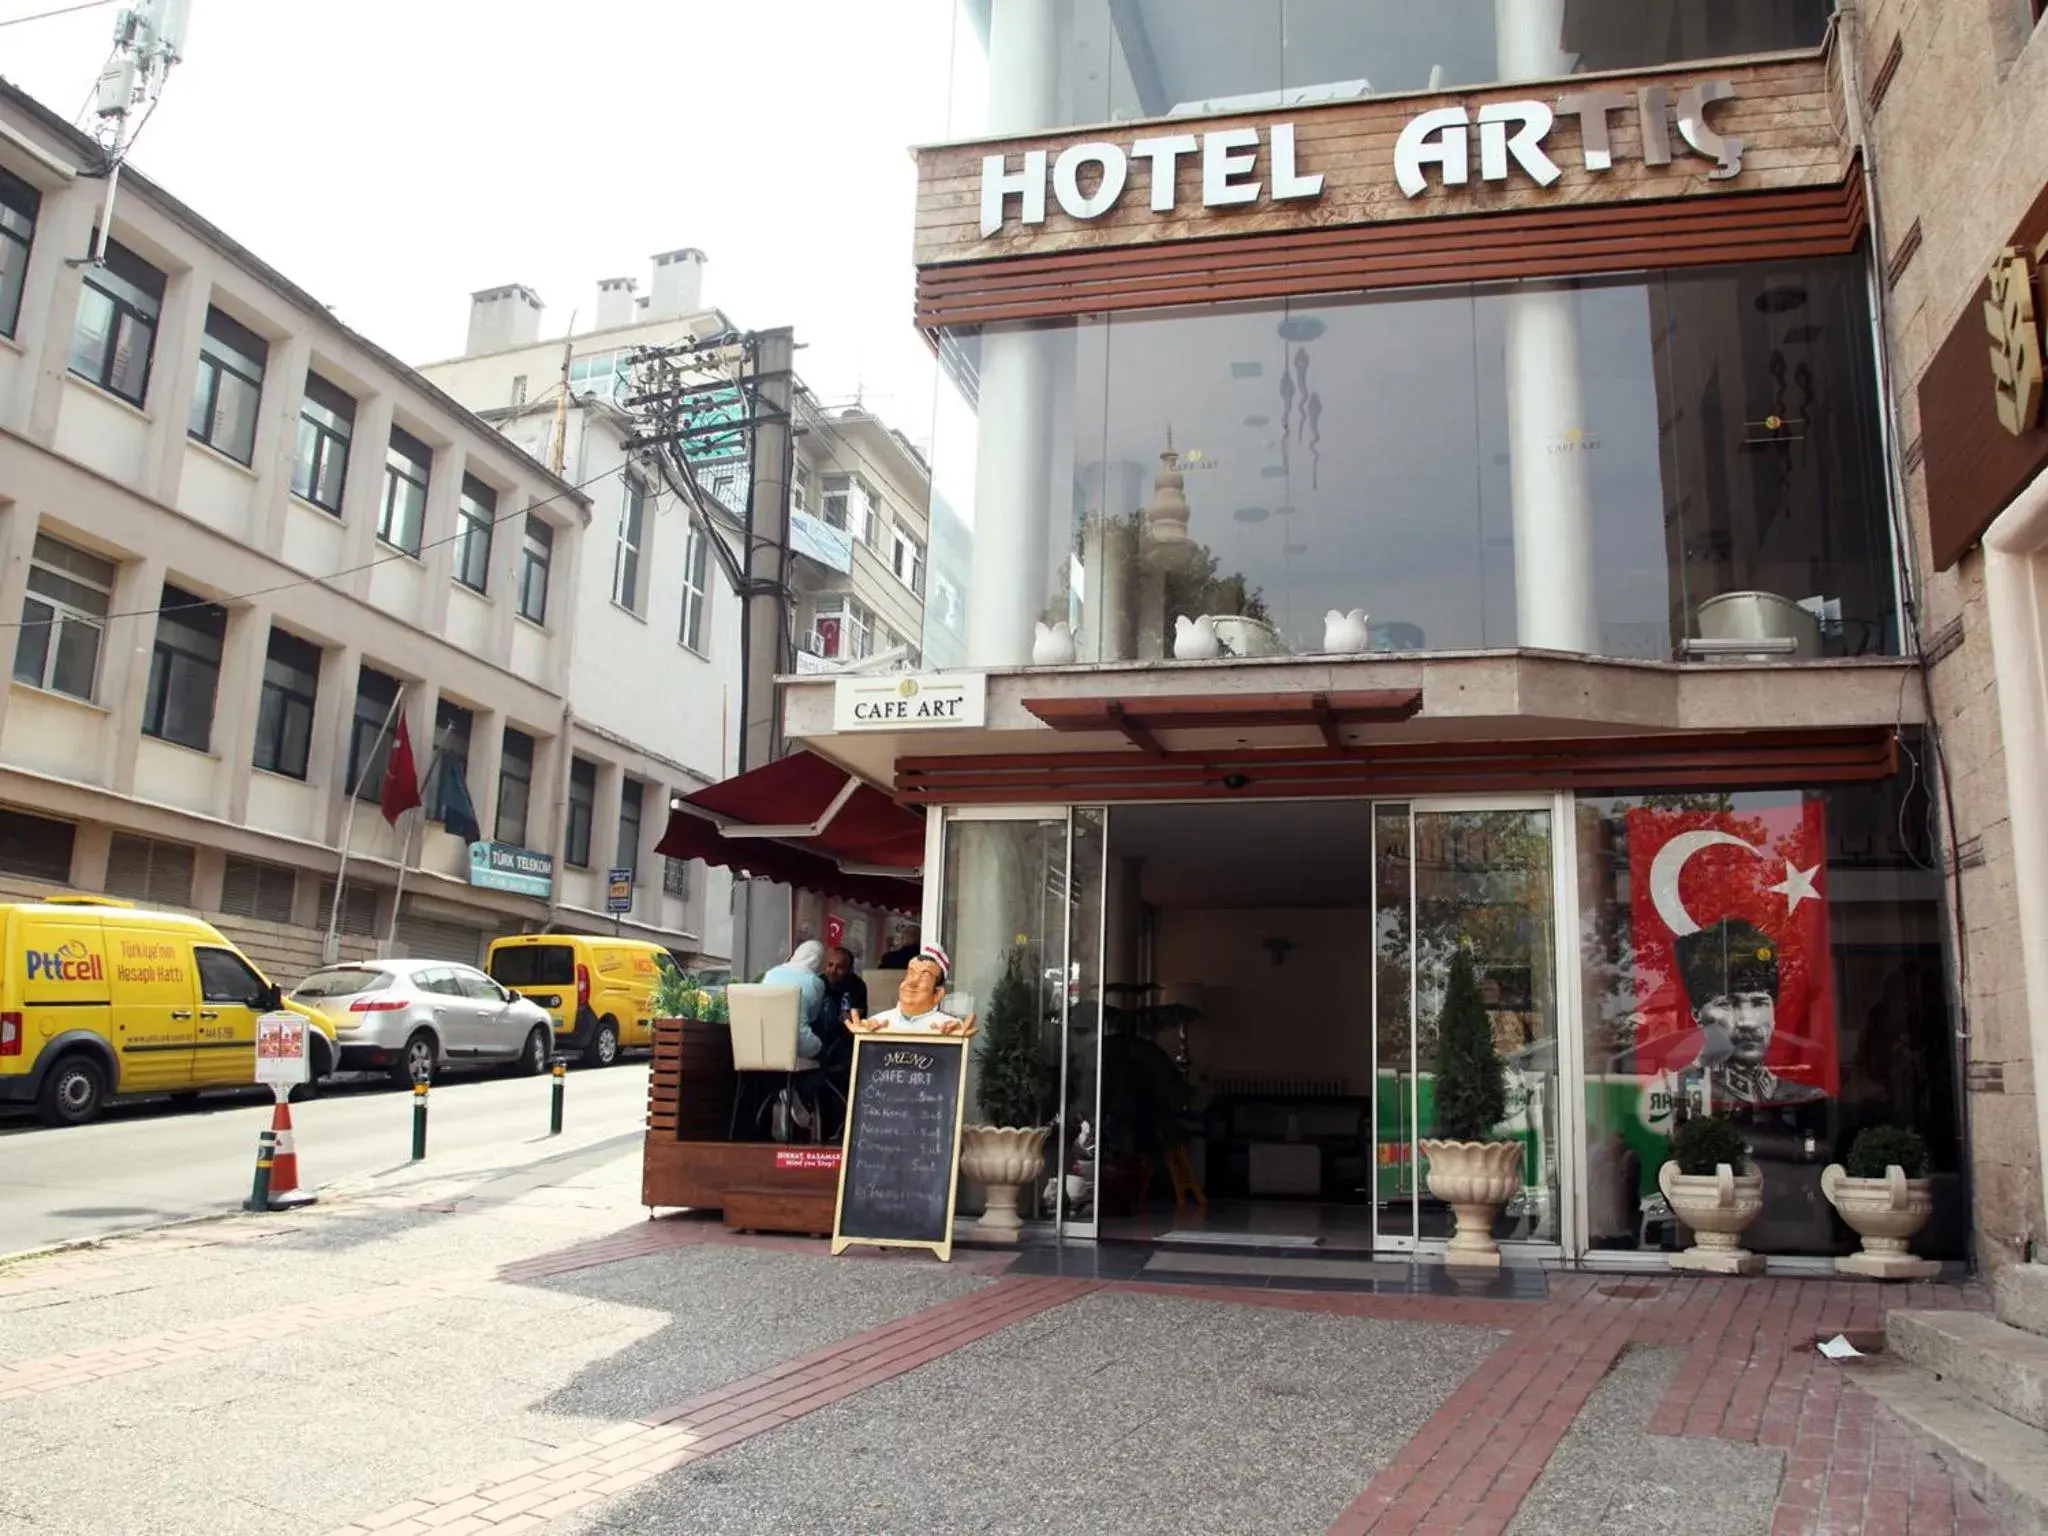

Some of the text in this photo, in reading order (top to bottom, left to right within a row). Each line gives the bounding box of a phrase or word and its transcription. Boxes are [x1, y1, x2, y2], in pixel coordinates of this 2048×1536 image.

[979, 121, 1326, 239] HOTEL
[854, 701, 908, 719] CAFE
[491, 849, 552, 873] TÜRK TELEKOM
[26, 949, 104, 981] Pttcell
[883, 1049, 934, 1070] MENU
[871, 1069, 934, 1086] CAFE ART
